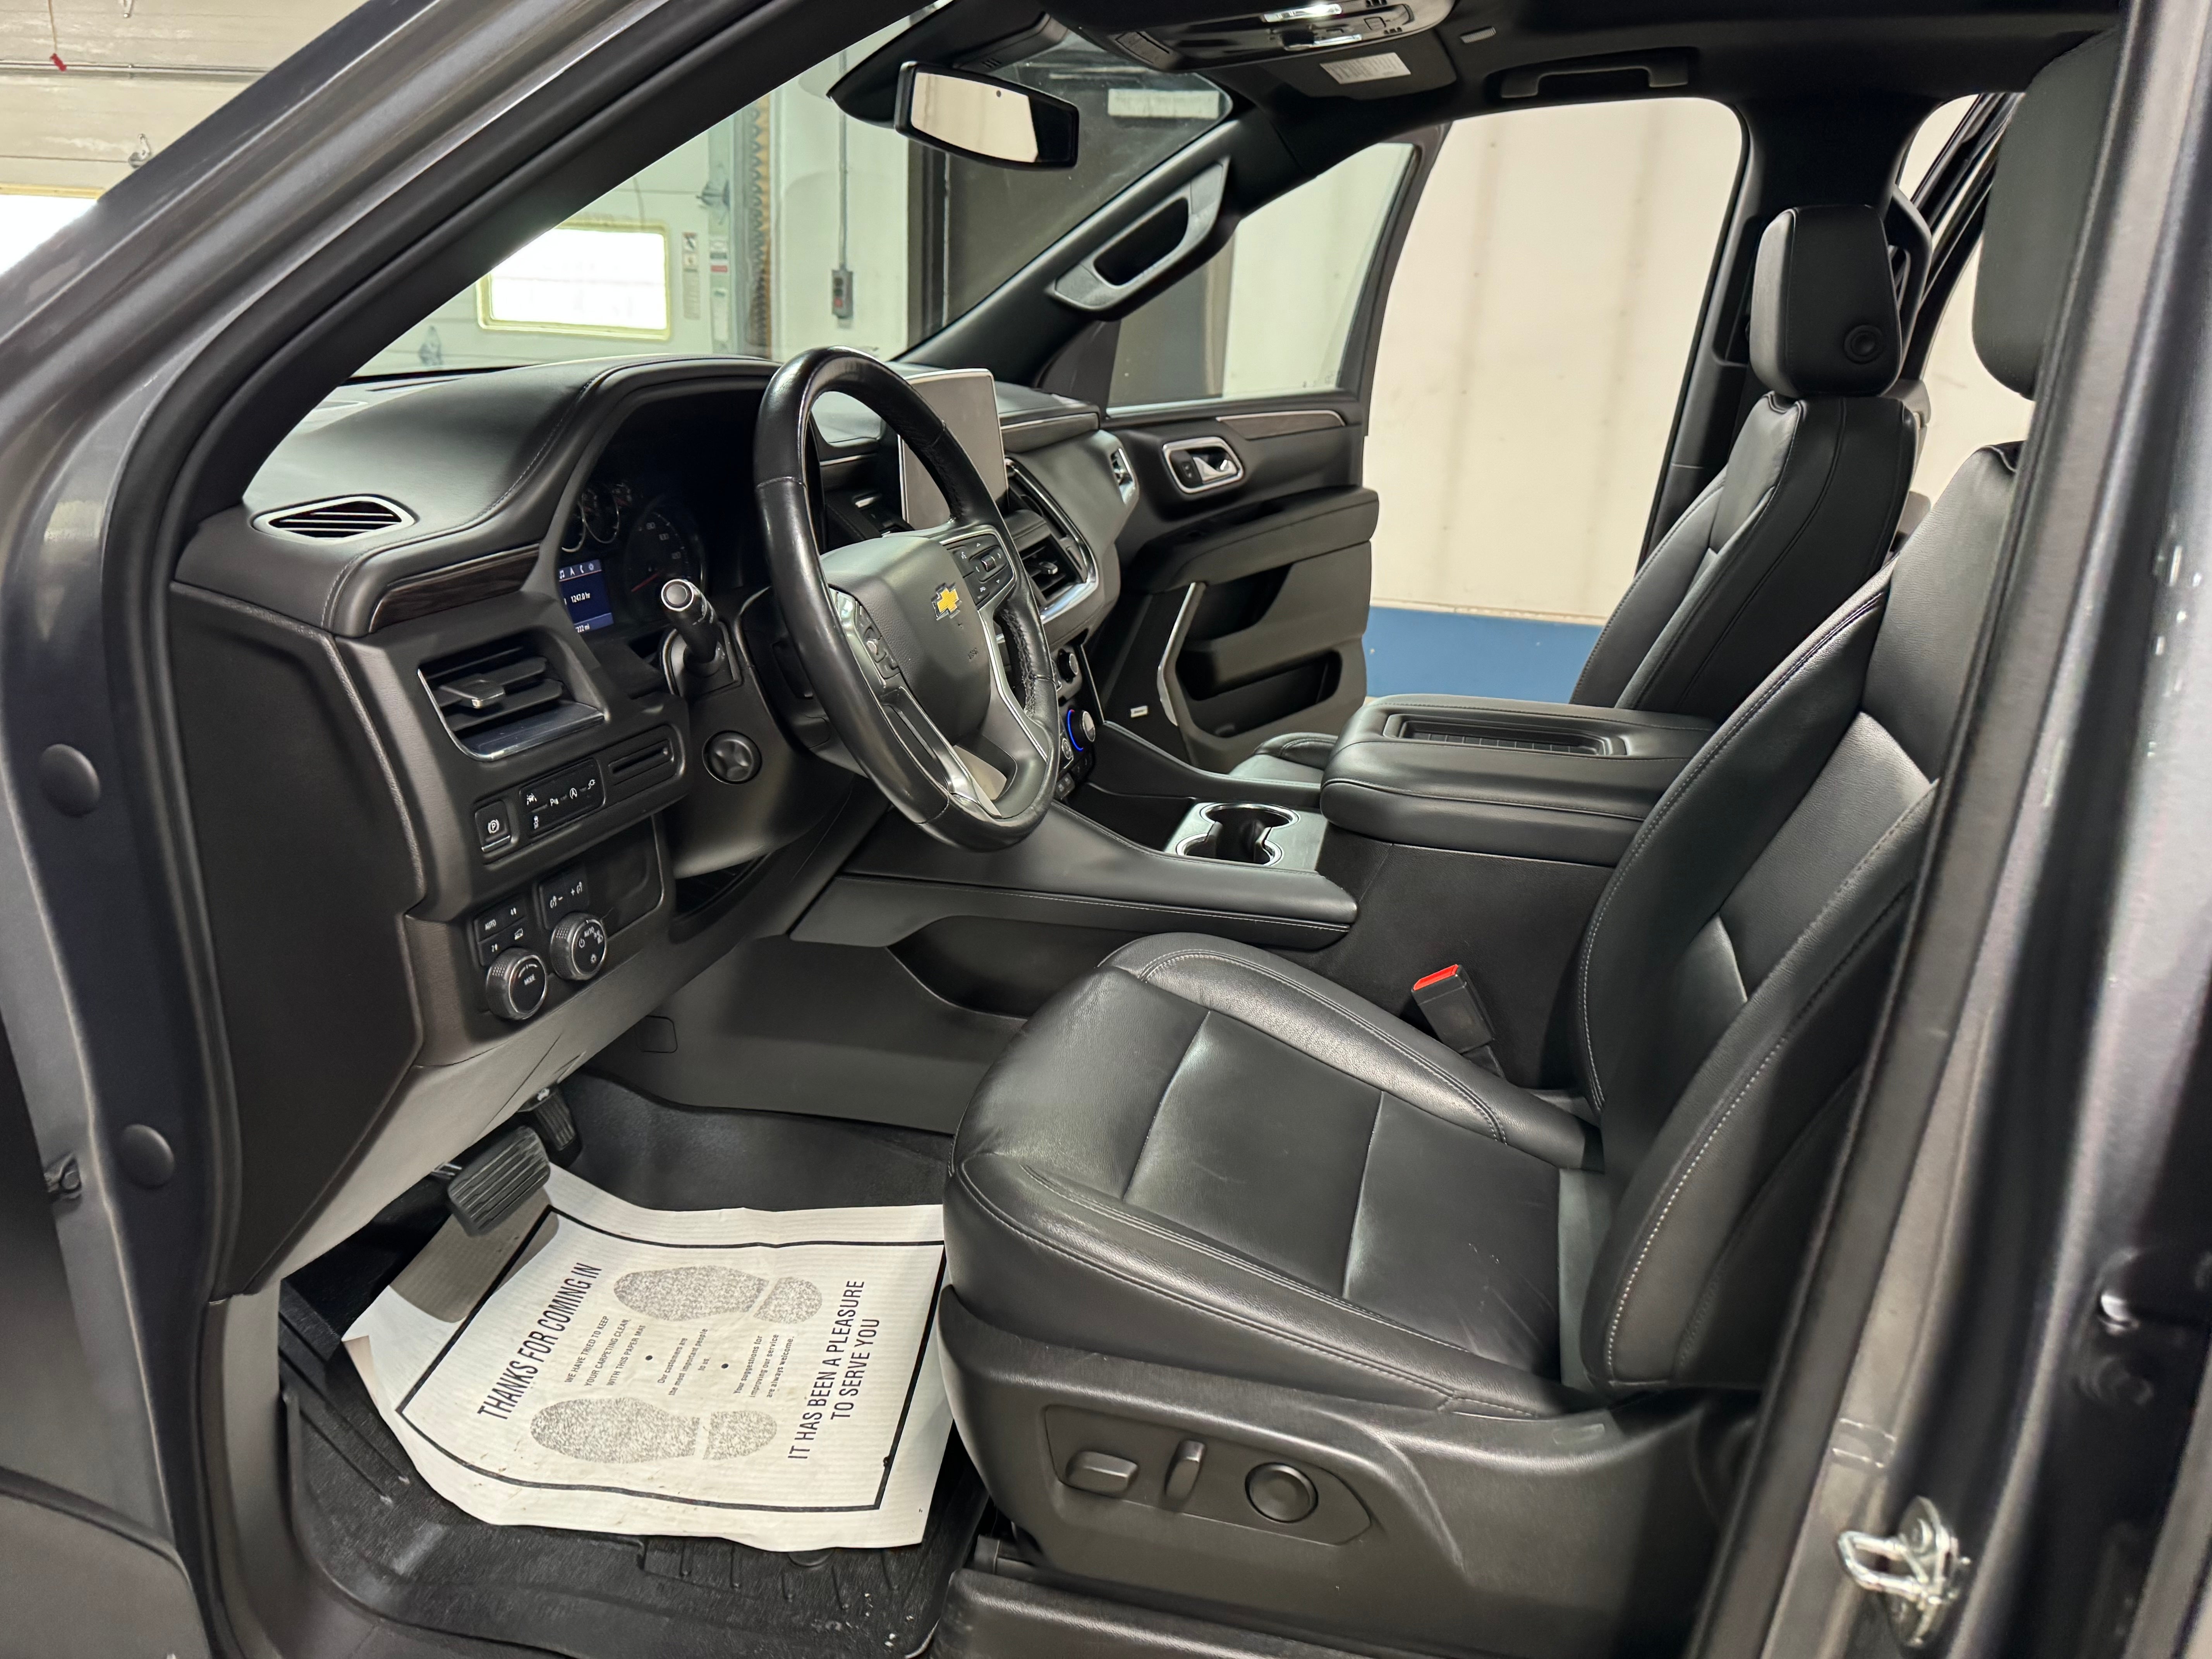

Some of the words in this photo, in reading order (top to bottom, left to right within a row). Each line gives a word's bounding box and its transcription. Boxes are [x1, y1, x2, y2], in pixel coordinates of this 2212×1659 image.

[485, 919, 496, 930] AUTO
[584, 926, 594, 938] AUTO
[571, 1262, 602, 1278] IN
[537, 1278, 592, 1331] COMING
[826, 1281, 864, 1352] PLEASURE
[517, 1331, 558, 1362] FOR
[564, 1373, 576, 1383] WE
[571, 1356, 586, 1372] HAVE
[581, 1339, 596, 1355] TRIED
[598, 1316, 609, 1330] KEEP
[766, 1334, 779, 1357] service
[854, 1319, 879, 1347] YOU
[584, 1370, 599, 1386] YOUR
[595, 1338, 618, 1369] CARPETING
[613, 1318, 631, 1337] CLEAN,
[606, 1371, 620, 1386] WITH
[615, 1357, 628, 1369] THIS
[624, 1338, 639, 1355] PAPER
[634, 1325, 646, 1336] MAT
[657, 1374, 668, 1383] Our
[665, 1346, 683, 1373] customers
[668, 1387, 678, 1395] the
[675, 1373, 685, 1386] most
[680, 1347, 699, 1371] important
[695, 1329, 708, 1346] people
[733, 1382, 744, 1394] Your
[741, 1346, 759, 1381] suggestions
[754, 1335, 763, 1345] for
[763, 1358, 771, 1368] our
[766, 1388, 775, 1398] are
[771, 1367, 783, 1387] always
[779, 1336, 794, 1365] welcome.
[822, 1357, 842, 1367] A
[477, 1360, 538, 1419] THANKS
[749, 1369, 768, 1398] improving
[807, 1371, 837, 1407] BEEN
[839, 1352, 870, 1396] SERVE
[794, 1412, 822, 1440] HAS
[830, 1402, 854, 1420] TO
[788, 1445, 810, 1459] IT
